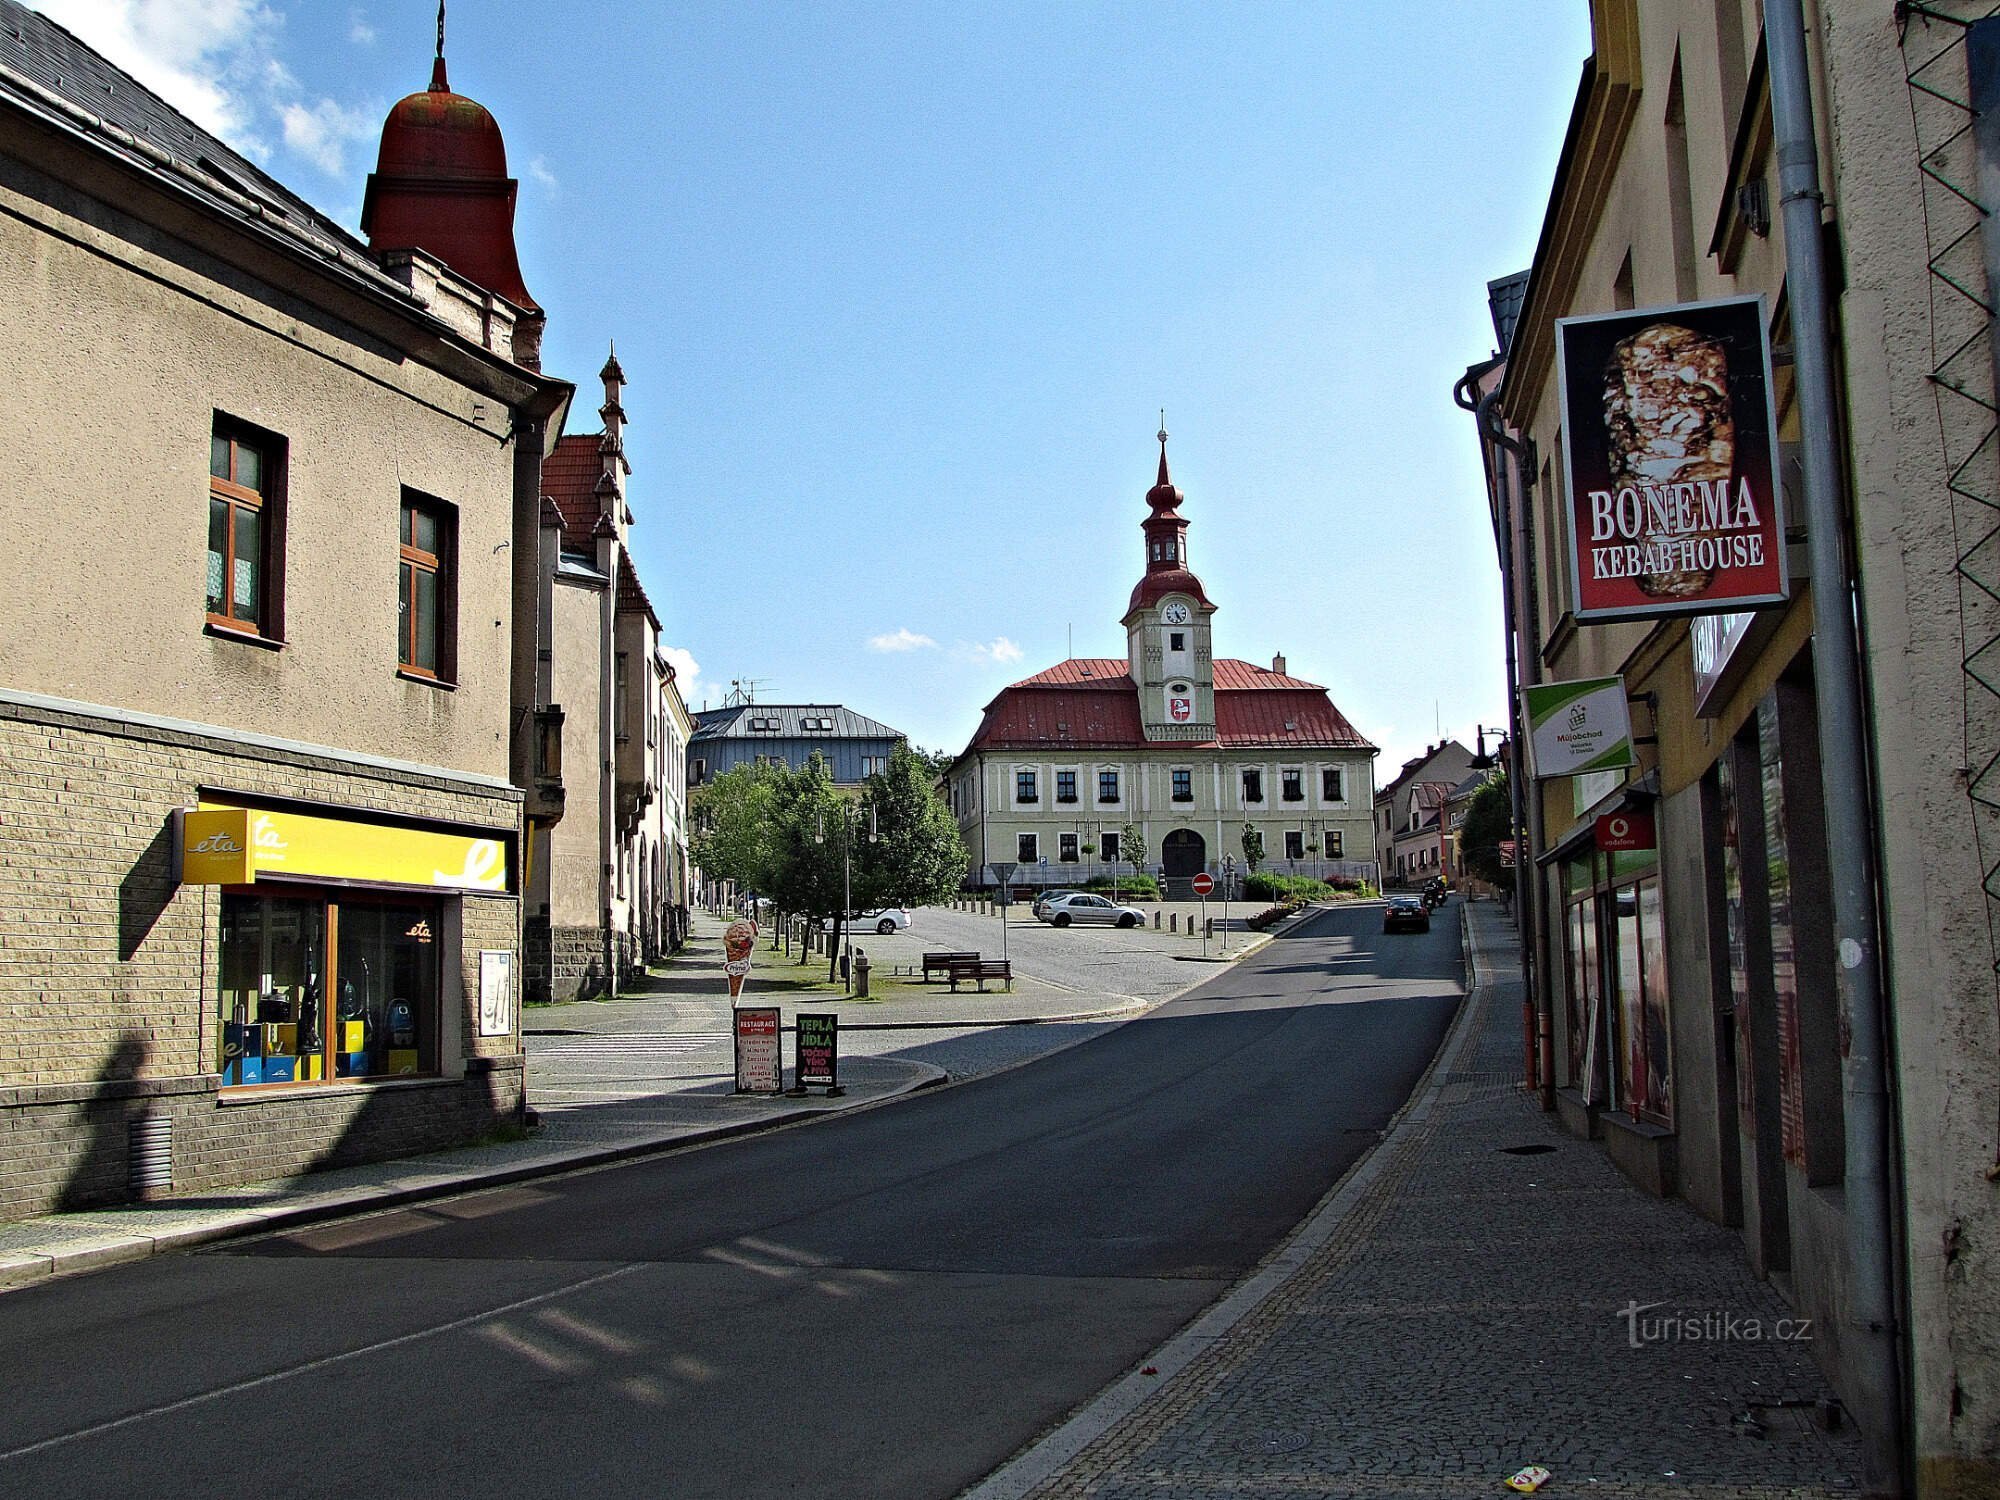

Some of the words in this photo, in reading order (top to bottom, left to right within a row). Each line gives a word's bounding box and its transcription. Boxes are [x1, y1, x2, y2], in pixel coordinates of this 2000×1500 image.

[1588, 476, 1760, 541] BONEMA
[1592, 541, 1675, 579] KEBAB
[1680, 534, 1764, 572] HOUSE
[254, 815, 289, 848] ta
[187, 832, 243, 853] eta
[1604, 838, 1636, 846] vodafone
[405, 919, 432, 937] eta
[740, 1020, 775, 1028] RESTAURACE
[799, 1016, 834, 1031] TEPLÁ
[800, 1032, 833, 1047] JÍDLA
